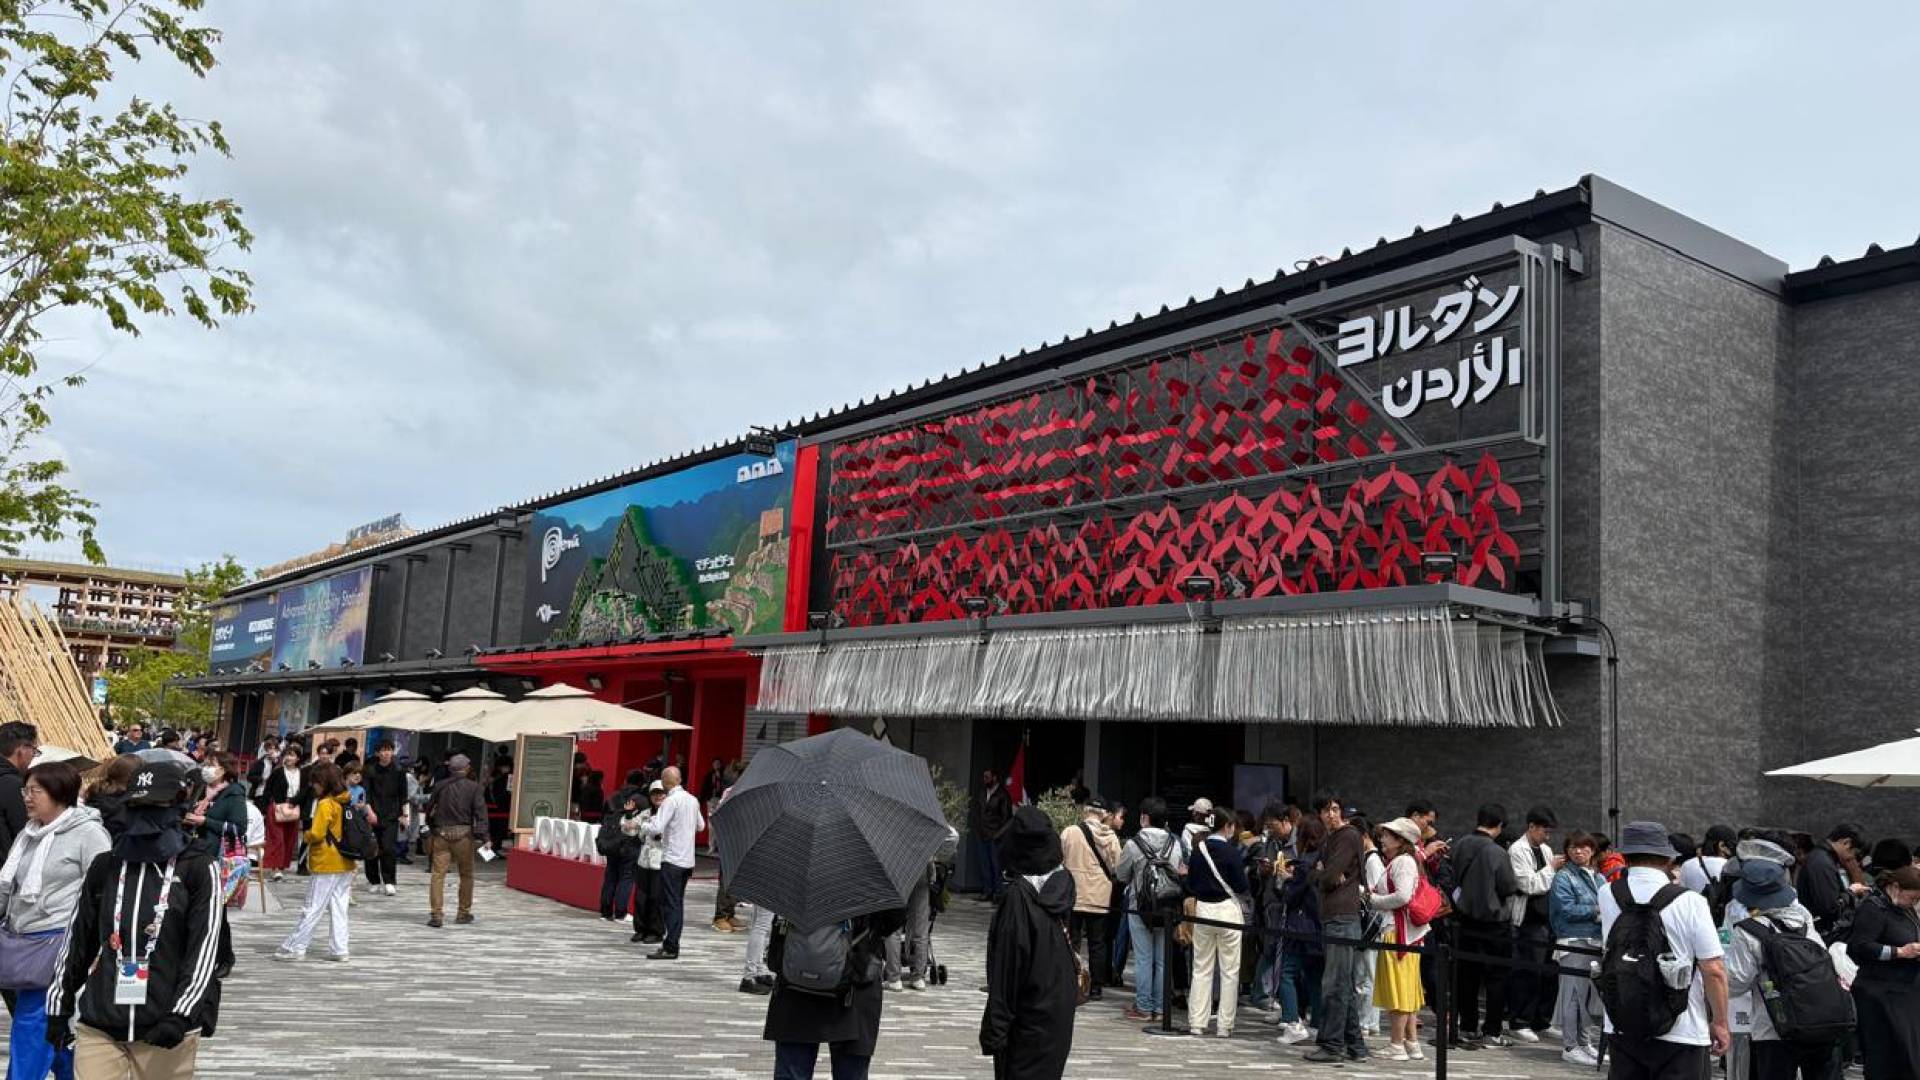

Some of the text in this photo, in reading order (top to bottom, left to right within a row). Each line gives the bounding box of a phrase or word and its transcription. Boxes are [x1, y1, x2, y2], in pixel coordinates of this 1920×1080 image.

[1337, 274, 1521, 368] ヨルダン
[1382, 336, 1521, 418] الأردن
[695, 554, 735, 571] マチュピチュ
